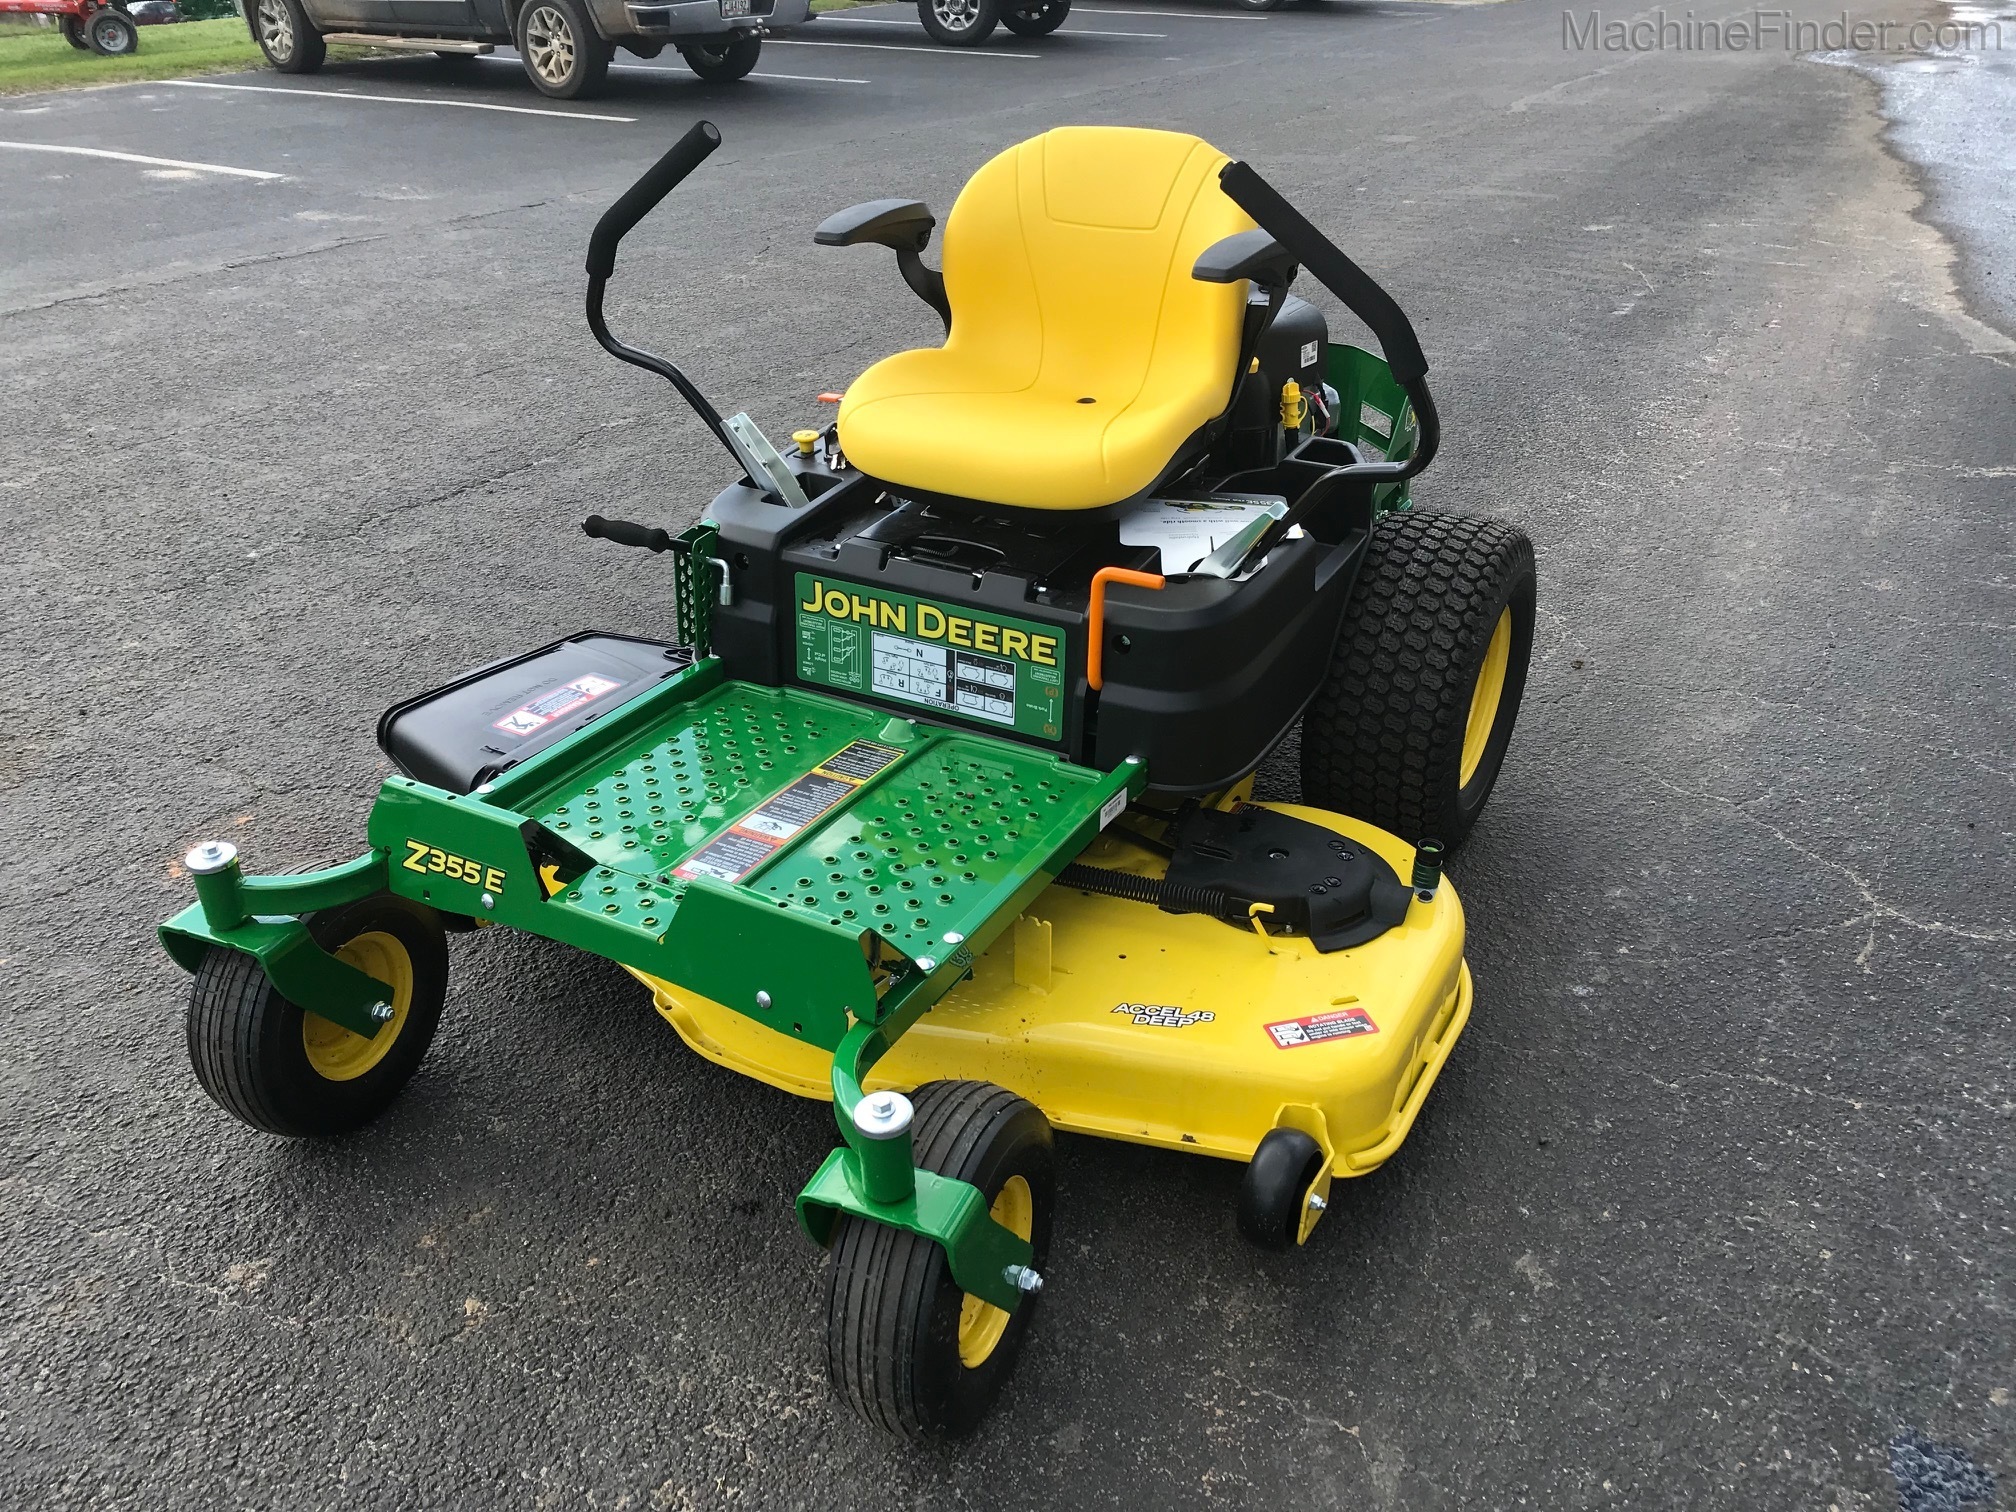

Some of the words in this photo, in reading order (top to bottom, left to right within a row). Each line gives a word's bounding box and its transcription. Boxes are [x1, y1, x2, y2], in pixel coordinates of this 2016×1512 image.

[802, 580, 907, 633] JOHN
[915, 602, 1058, 667] DEERE
[916, 648, 923, 658] N
[898, 678, 904, 688] R
[924, 698, 960, 712] OPERATION
[402, 838, 482, 887] Z355
[484, 867, 508, 894] E
[1111, 1003, 1189, 1018] ACCEL
[1187, 1010, 1216, 1024] 48
[1317, 1012, 1348, 1021] DANGER
[1132, 1014, 1194, 1028] DEEP
